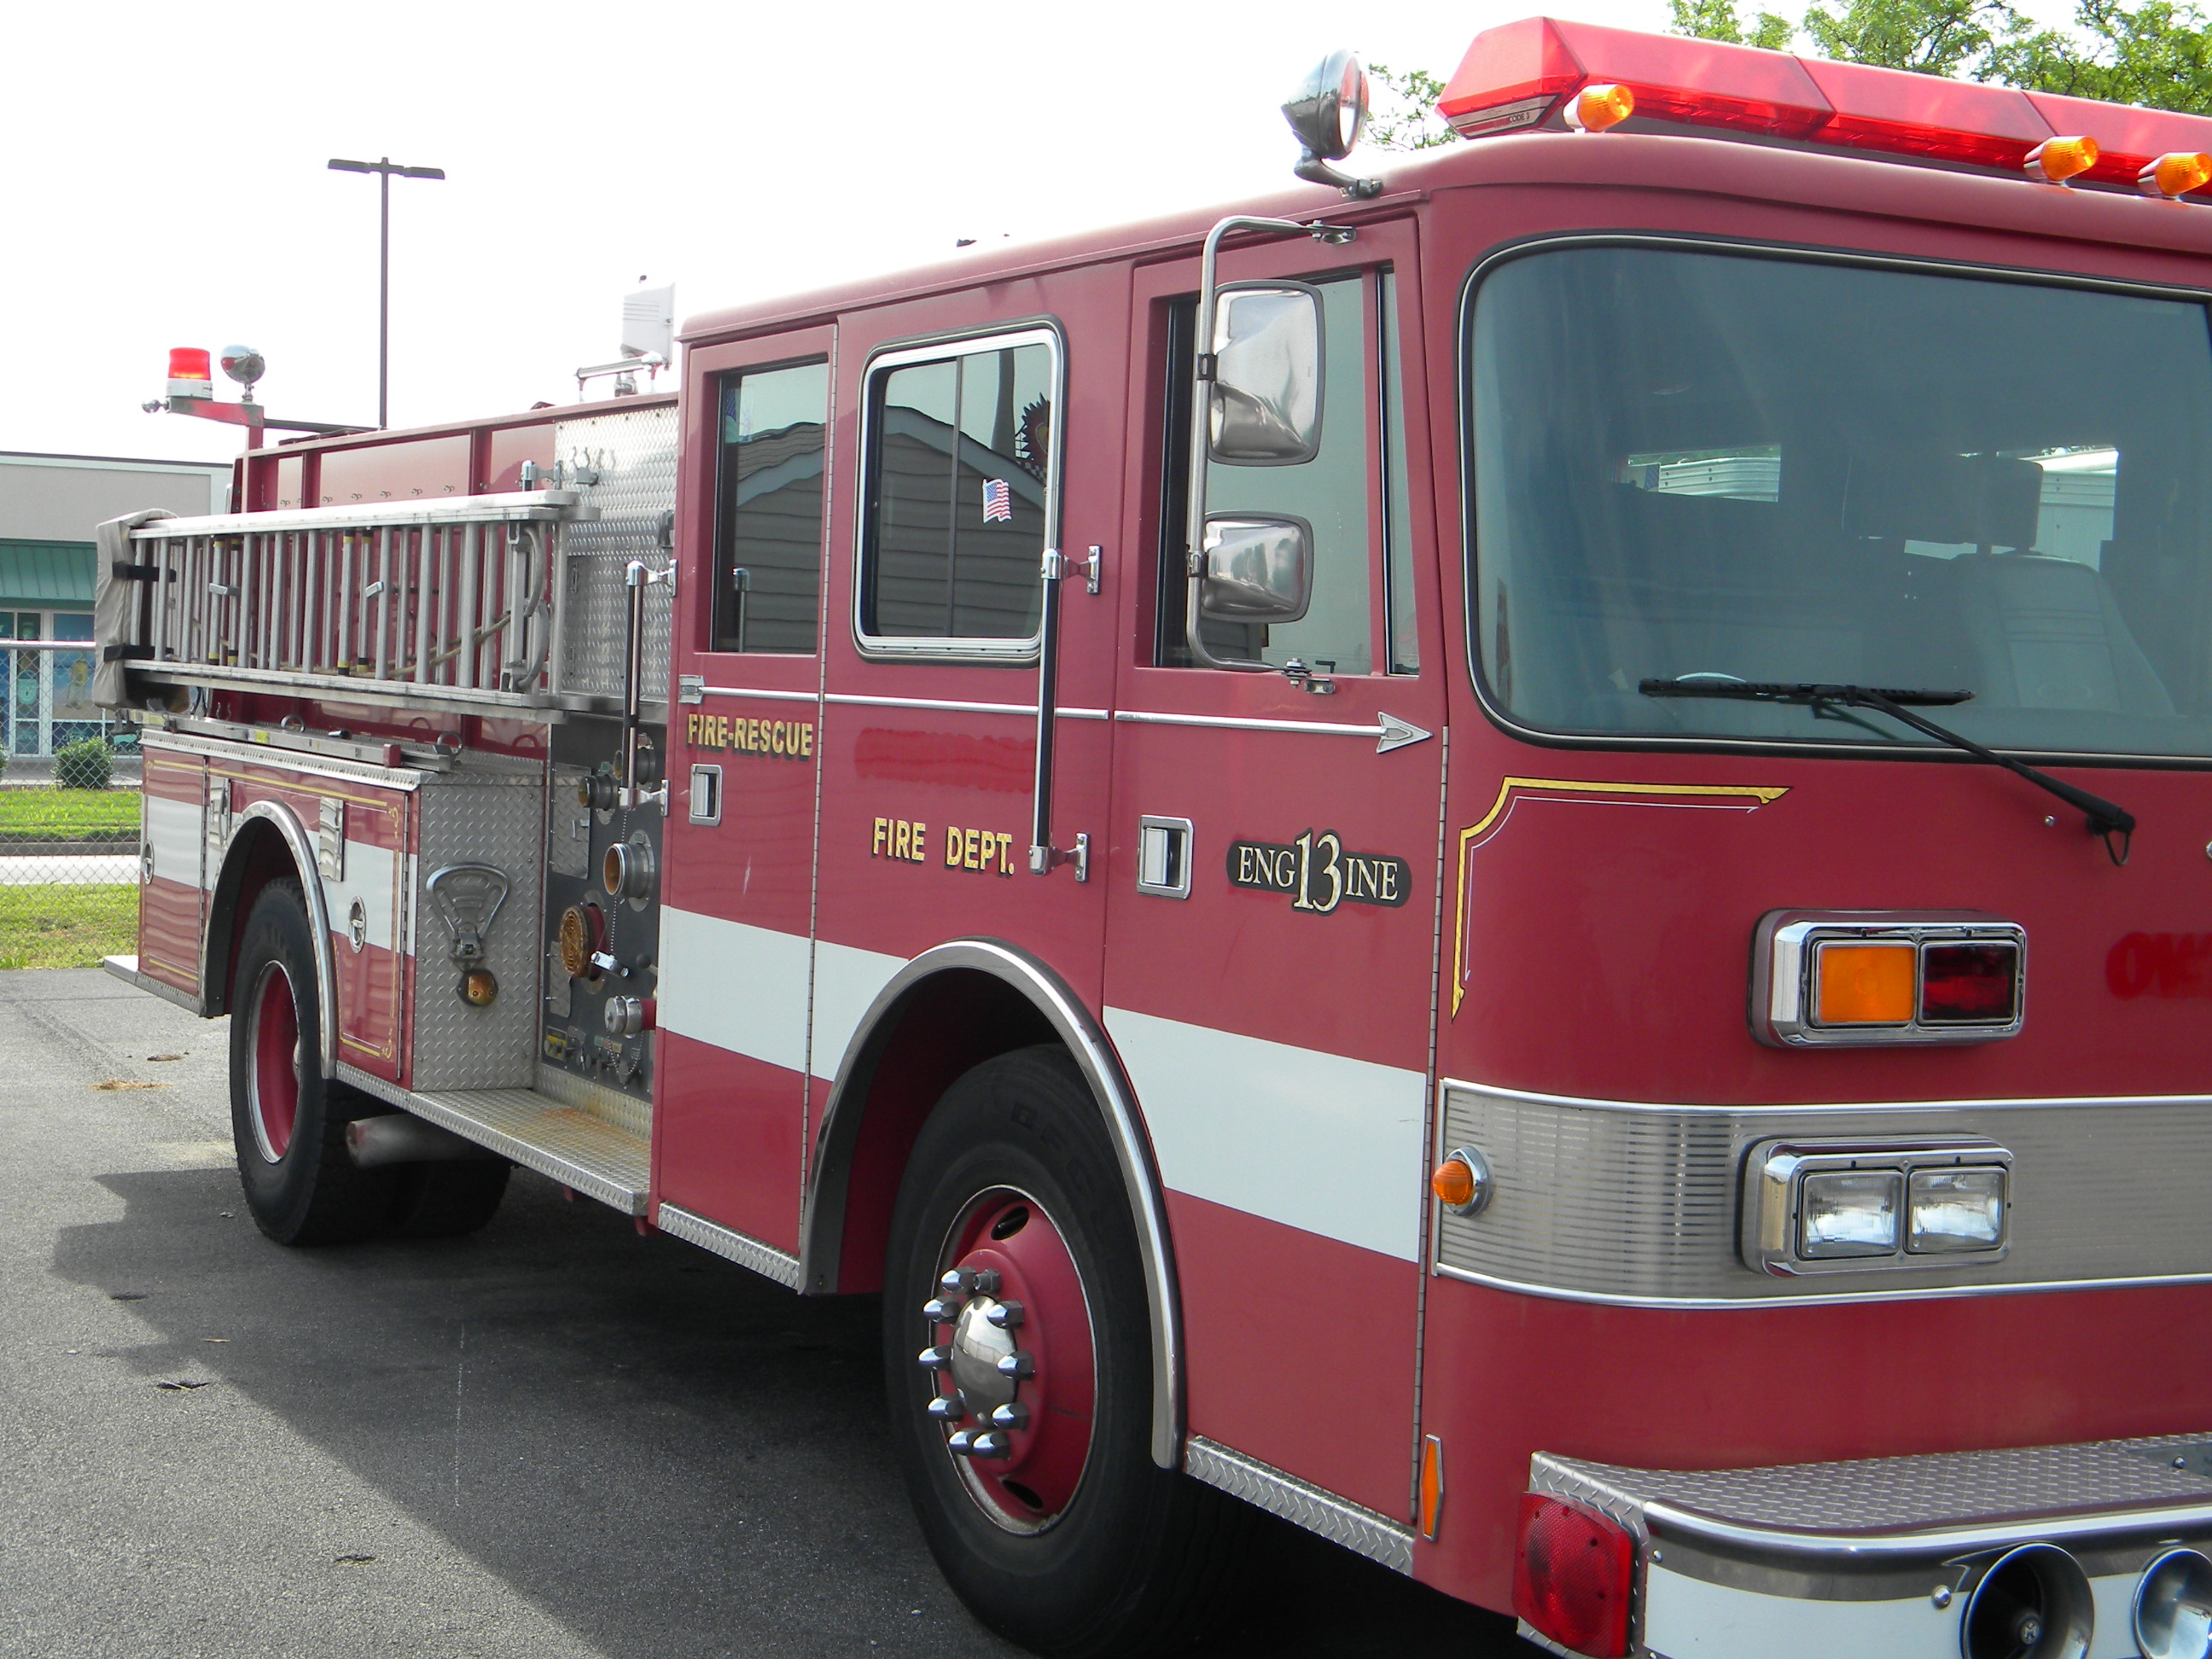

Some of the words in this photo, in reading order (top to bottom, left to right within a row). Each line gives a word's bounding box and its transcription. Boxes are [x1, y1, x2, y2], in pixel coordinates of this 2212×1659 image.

[1509, 113, 1525, 123] CODE
[687, 713, 813, 757] FIRE-RESCUE
[872, 817, 926, 861] FIRE
[946, 825, 1016, 876] DEPT.
